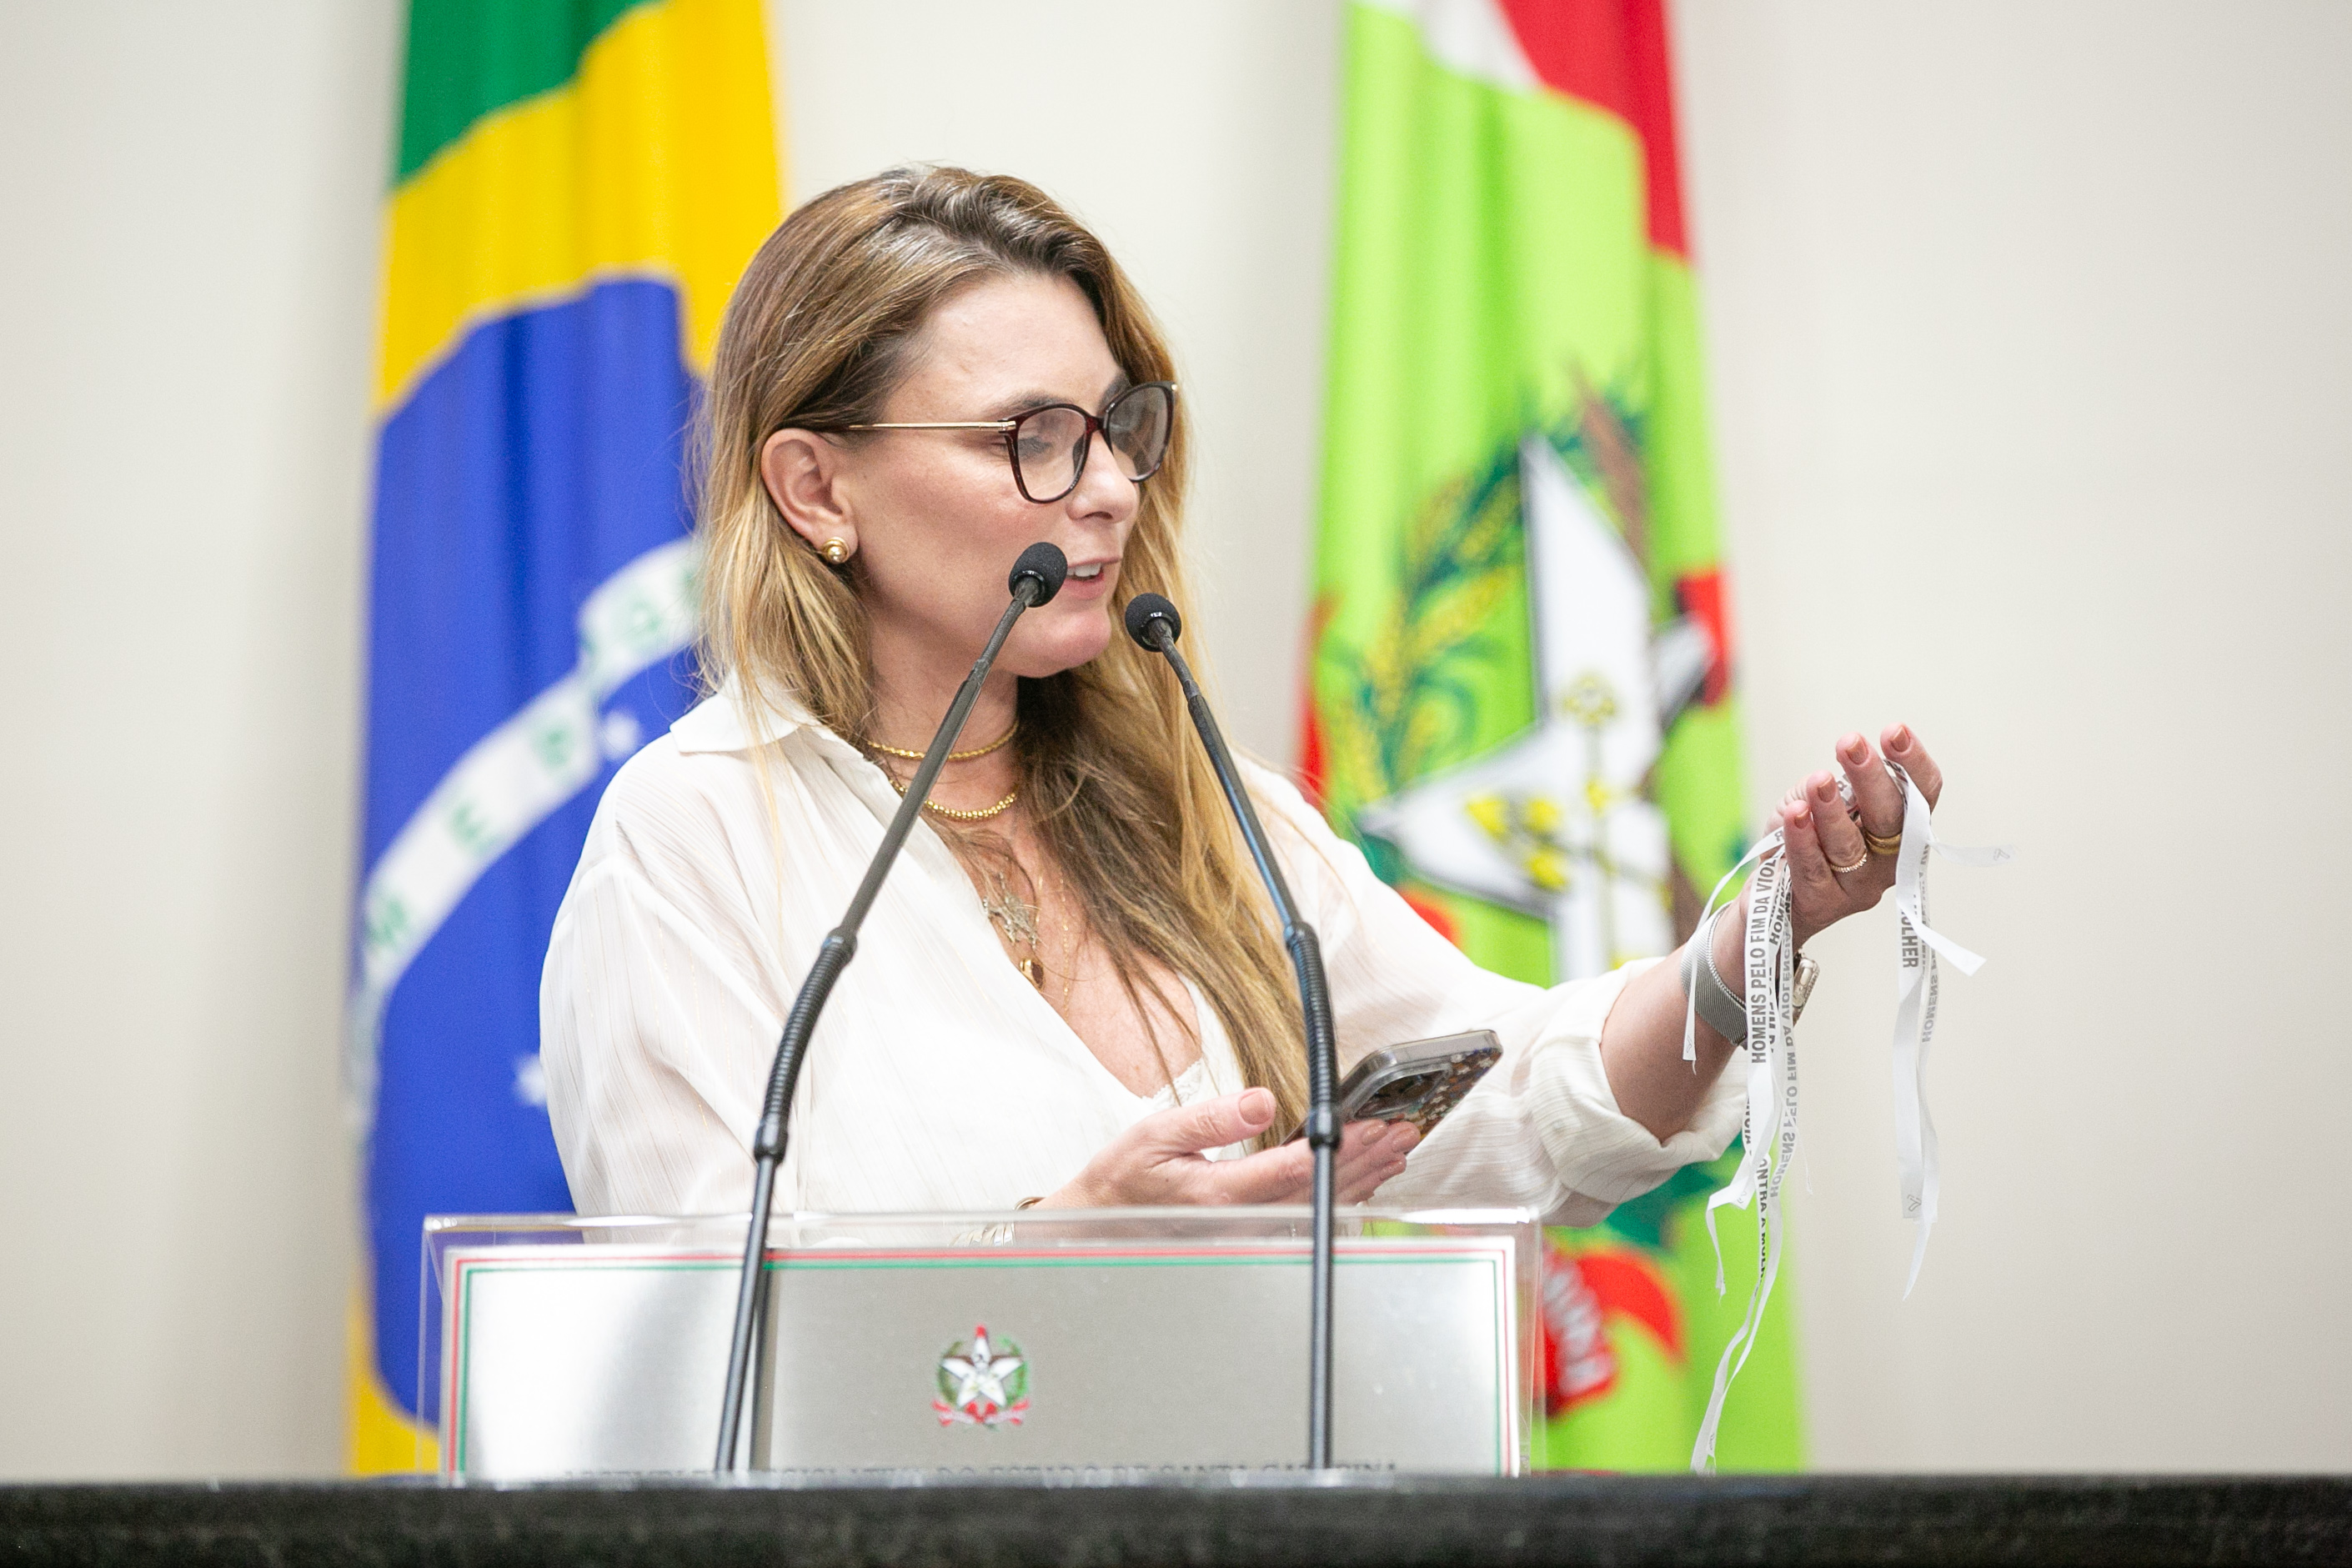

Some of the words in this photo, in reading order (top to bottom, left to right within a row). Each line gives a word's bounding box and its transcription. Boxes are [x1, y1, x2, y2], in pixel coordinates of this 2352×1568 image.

[1756, 858, 1777, 892] VIOL
[1753, 896, 1770, 914] DA
[1750, 917, 1766, 943] FIM
[1900, 911, 1919, 968] ULHER
[1750, 948, 1766, 989] PELO
[1751, 994, 1767, 1063] HOMENS
[1756, 1159, 1768, 1212] ONTRA
